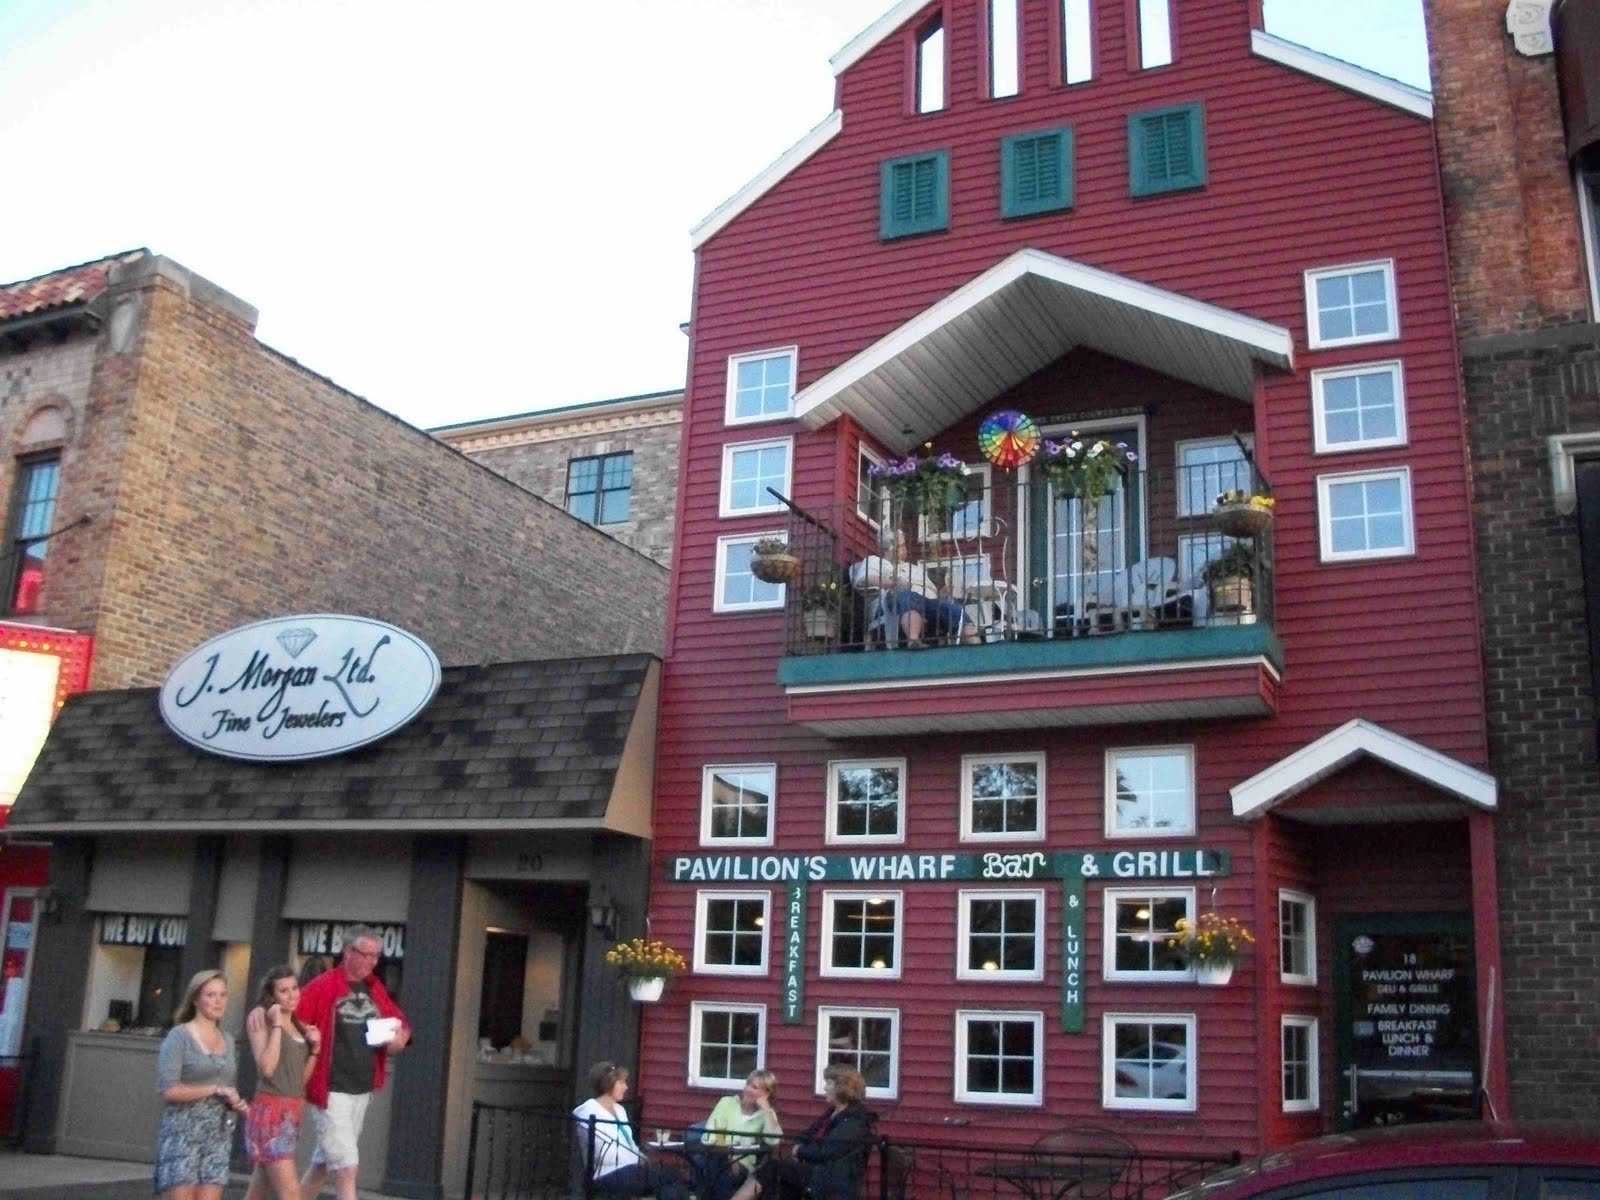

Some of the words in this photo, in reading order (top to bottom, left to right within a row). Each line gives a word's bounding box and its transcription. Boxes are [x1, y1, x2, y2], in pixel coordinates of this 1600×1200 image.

[176, 653, 220, 707] J.
[220, 650, 318, 722] Morgan
[323, 635, 391, 718] Ltd.
[202, 709, 250, 739] Fine
[263, 700, 347, 739] Jewelers
[674, 855, 828, 880] PAVILION'S
[850, 855, 956, 880] WHARF
[982, 852, 1046, 878] Bar
[1080, 853, 1099, 876] &
[1112, 851, 1214, 877] GRILL
[1069, 894, 1079, 908] &
[103, 917, 125, 942] WE
[127, 917, 158, 944] BUY
[303, 924, 328, 953] WE
[787, 887, 801, 1017] BREAKFAST
[1066, 924, 1079, 1003] LUNCH
[1362, 970, 1412, 981] PAVILION
[1415, 969, 1455, 980] WHARF
[1367, 1003, 1405, 1014] FAMILY
[1409, 1004, 1450, 1015] DINING
[1377, 1020, 1438, 1031] BREAKFAST
[1382, 1033, 1419, 1044] LUNCH
[1424, 1033, 1433, 1044] &
[1388, 1045, 1429, 1056] DINNER
